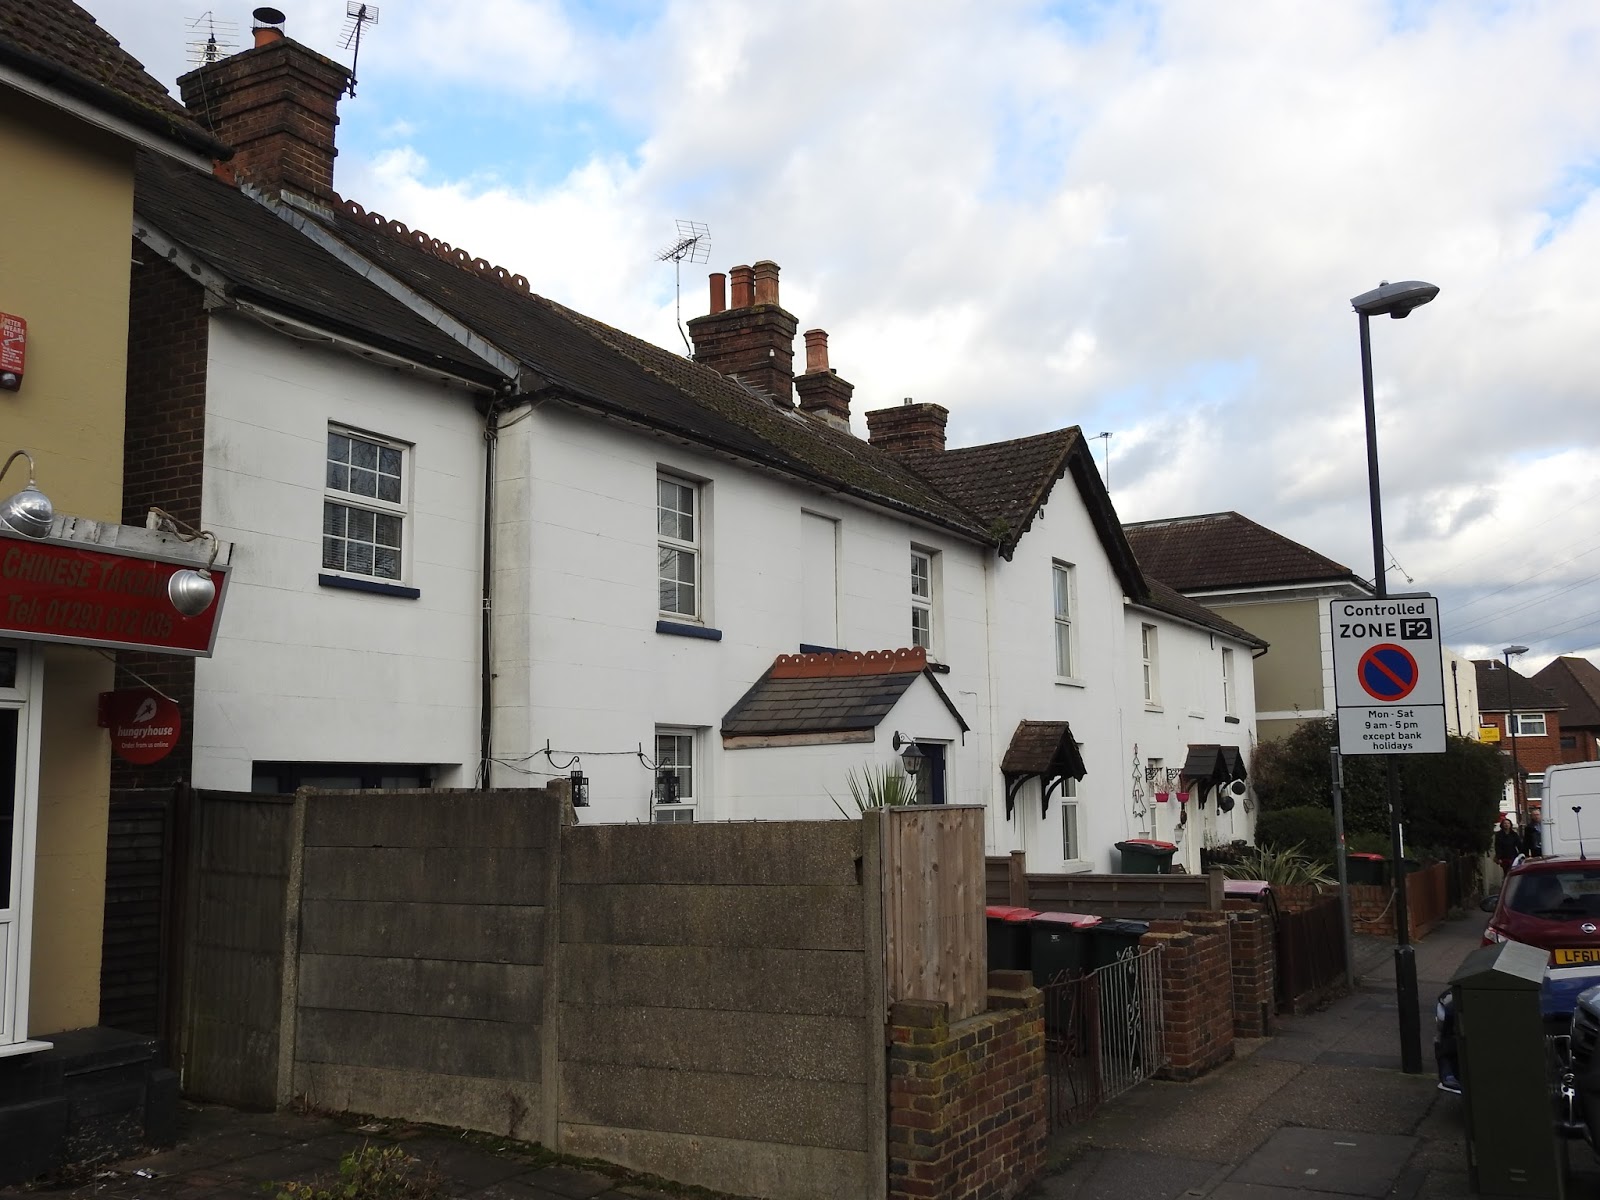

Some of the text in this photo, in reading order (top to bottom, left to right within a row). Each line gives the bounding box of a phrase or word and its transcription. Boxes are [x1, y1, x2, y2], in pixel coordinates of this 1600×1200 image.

[2, 546, 170, 600] CHINESE TAKEAW
[45, 598, 104, 631] 01293
[1344, 603, 1425, 616] Controlled
[1340, 621, 1428, 638] ZONE F2
[1368, 710, 1389, 718] Mon
[1397, 709, 1414, 718] Sat
[117, 725, 173, 738] hungryhouse
[1362, 731, 1422, 741] except bank
[153, 740, 169, 748] online
[1372, 741, 1413, 751] holidays
